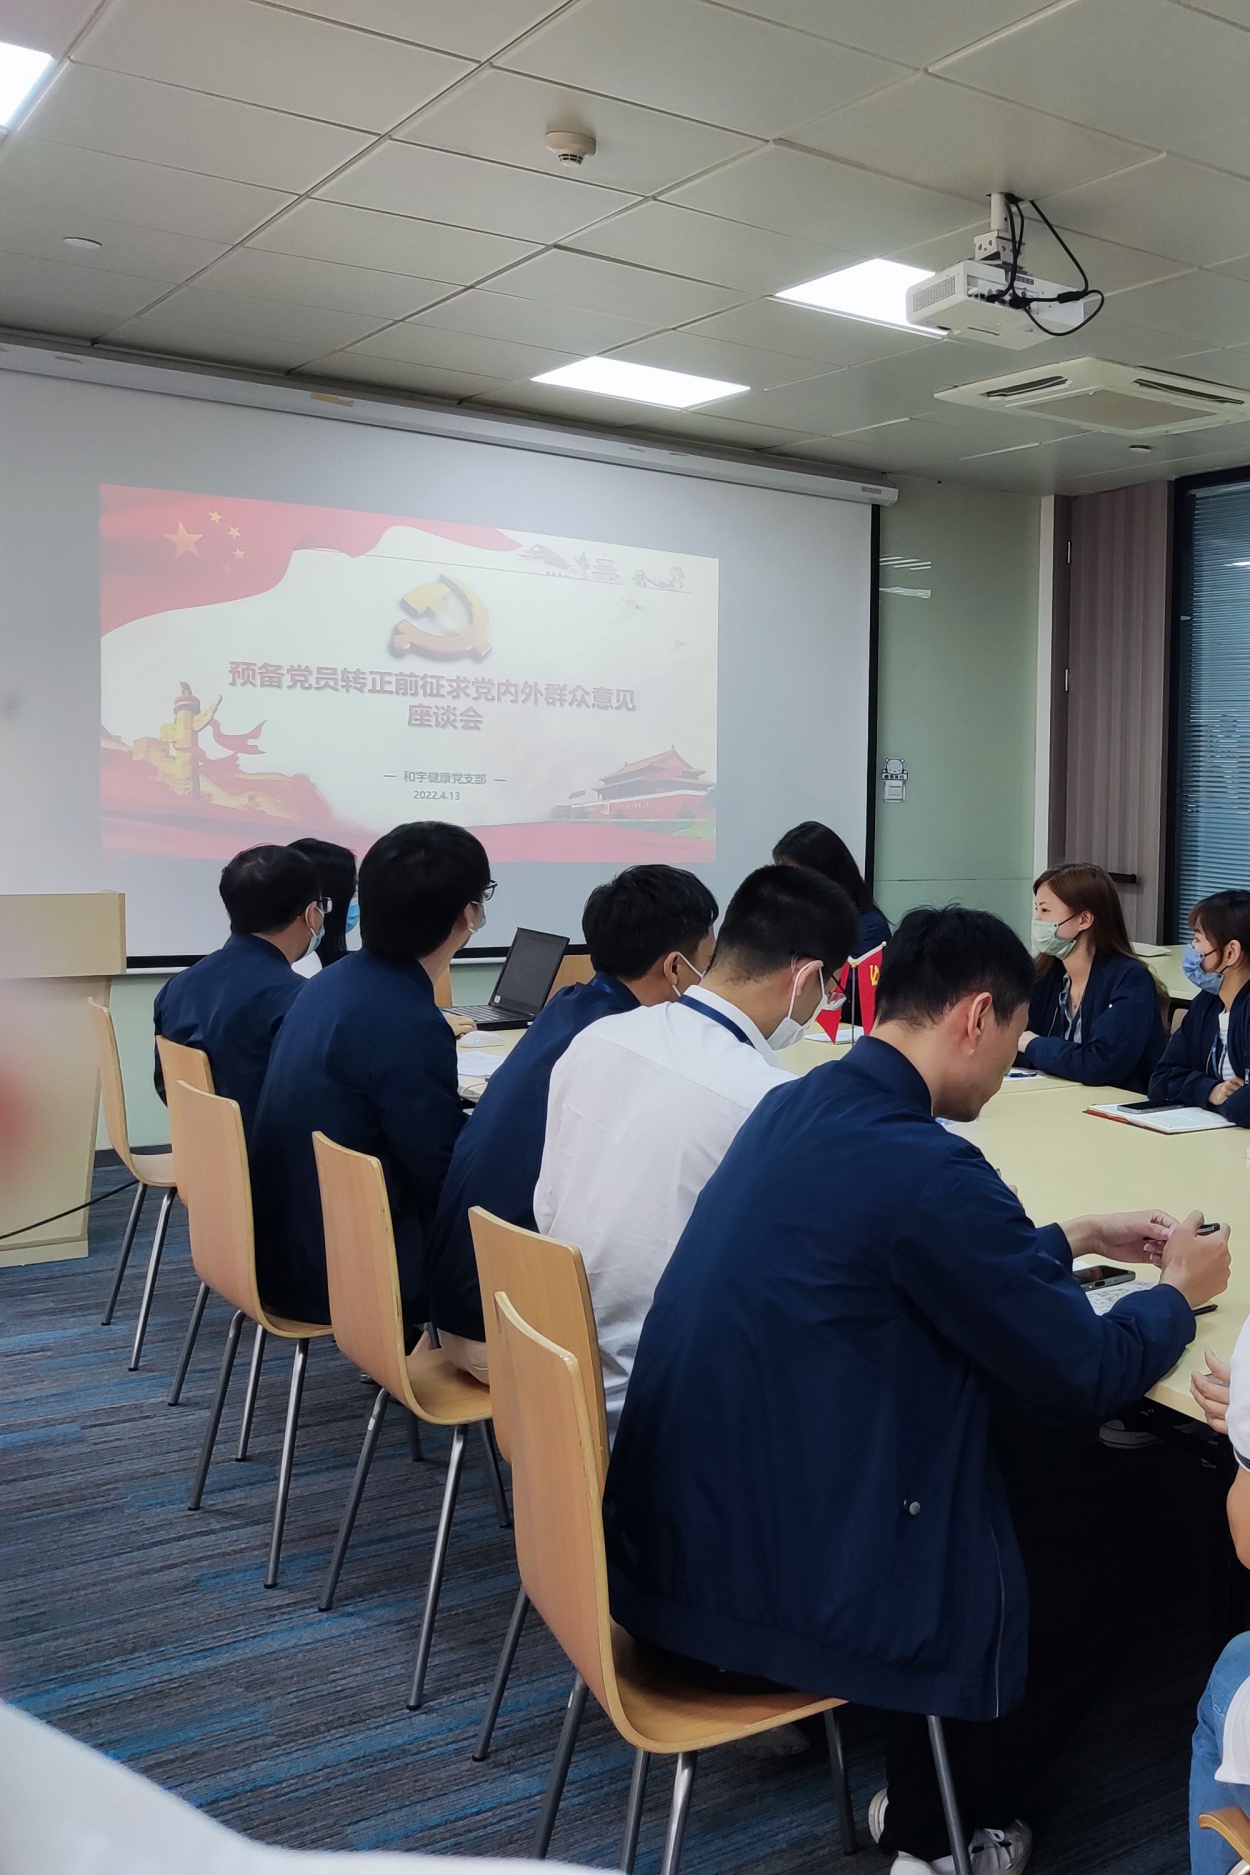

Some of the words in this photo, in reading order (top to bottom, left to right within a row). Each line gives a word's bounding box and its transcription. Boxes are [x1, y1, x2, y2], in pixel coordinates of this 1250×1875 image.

[228, 661, 636, 711] 预备党员转正前征求党内外群众意见
[407, 703, 483, 731] 座谈会
[403, 770, 487, 785] 和宇健康党支部
[413, 790, 460, 801] 2022.4.13
